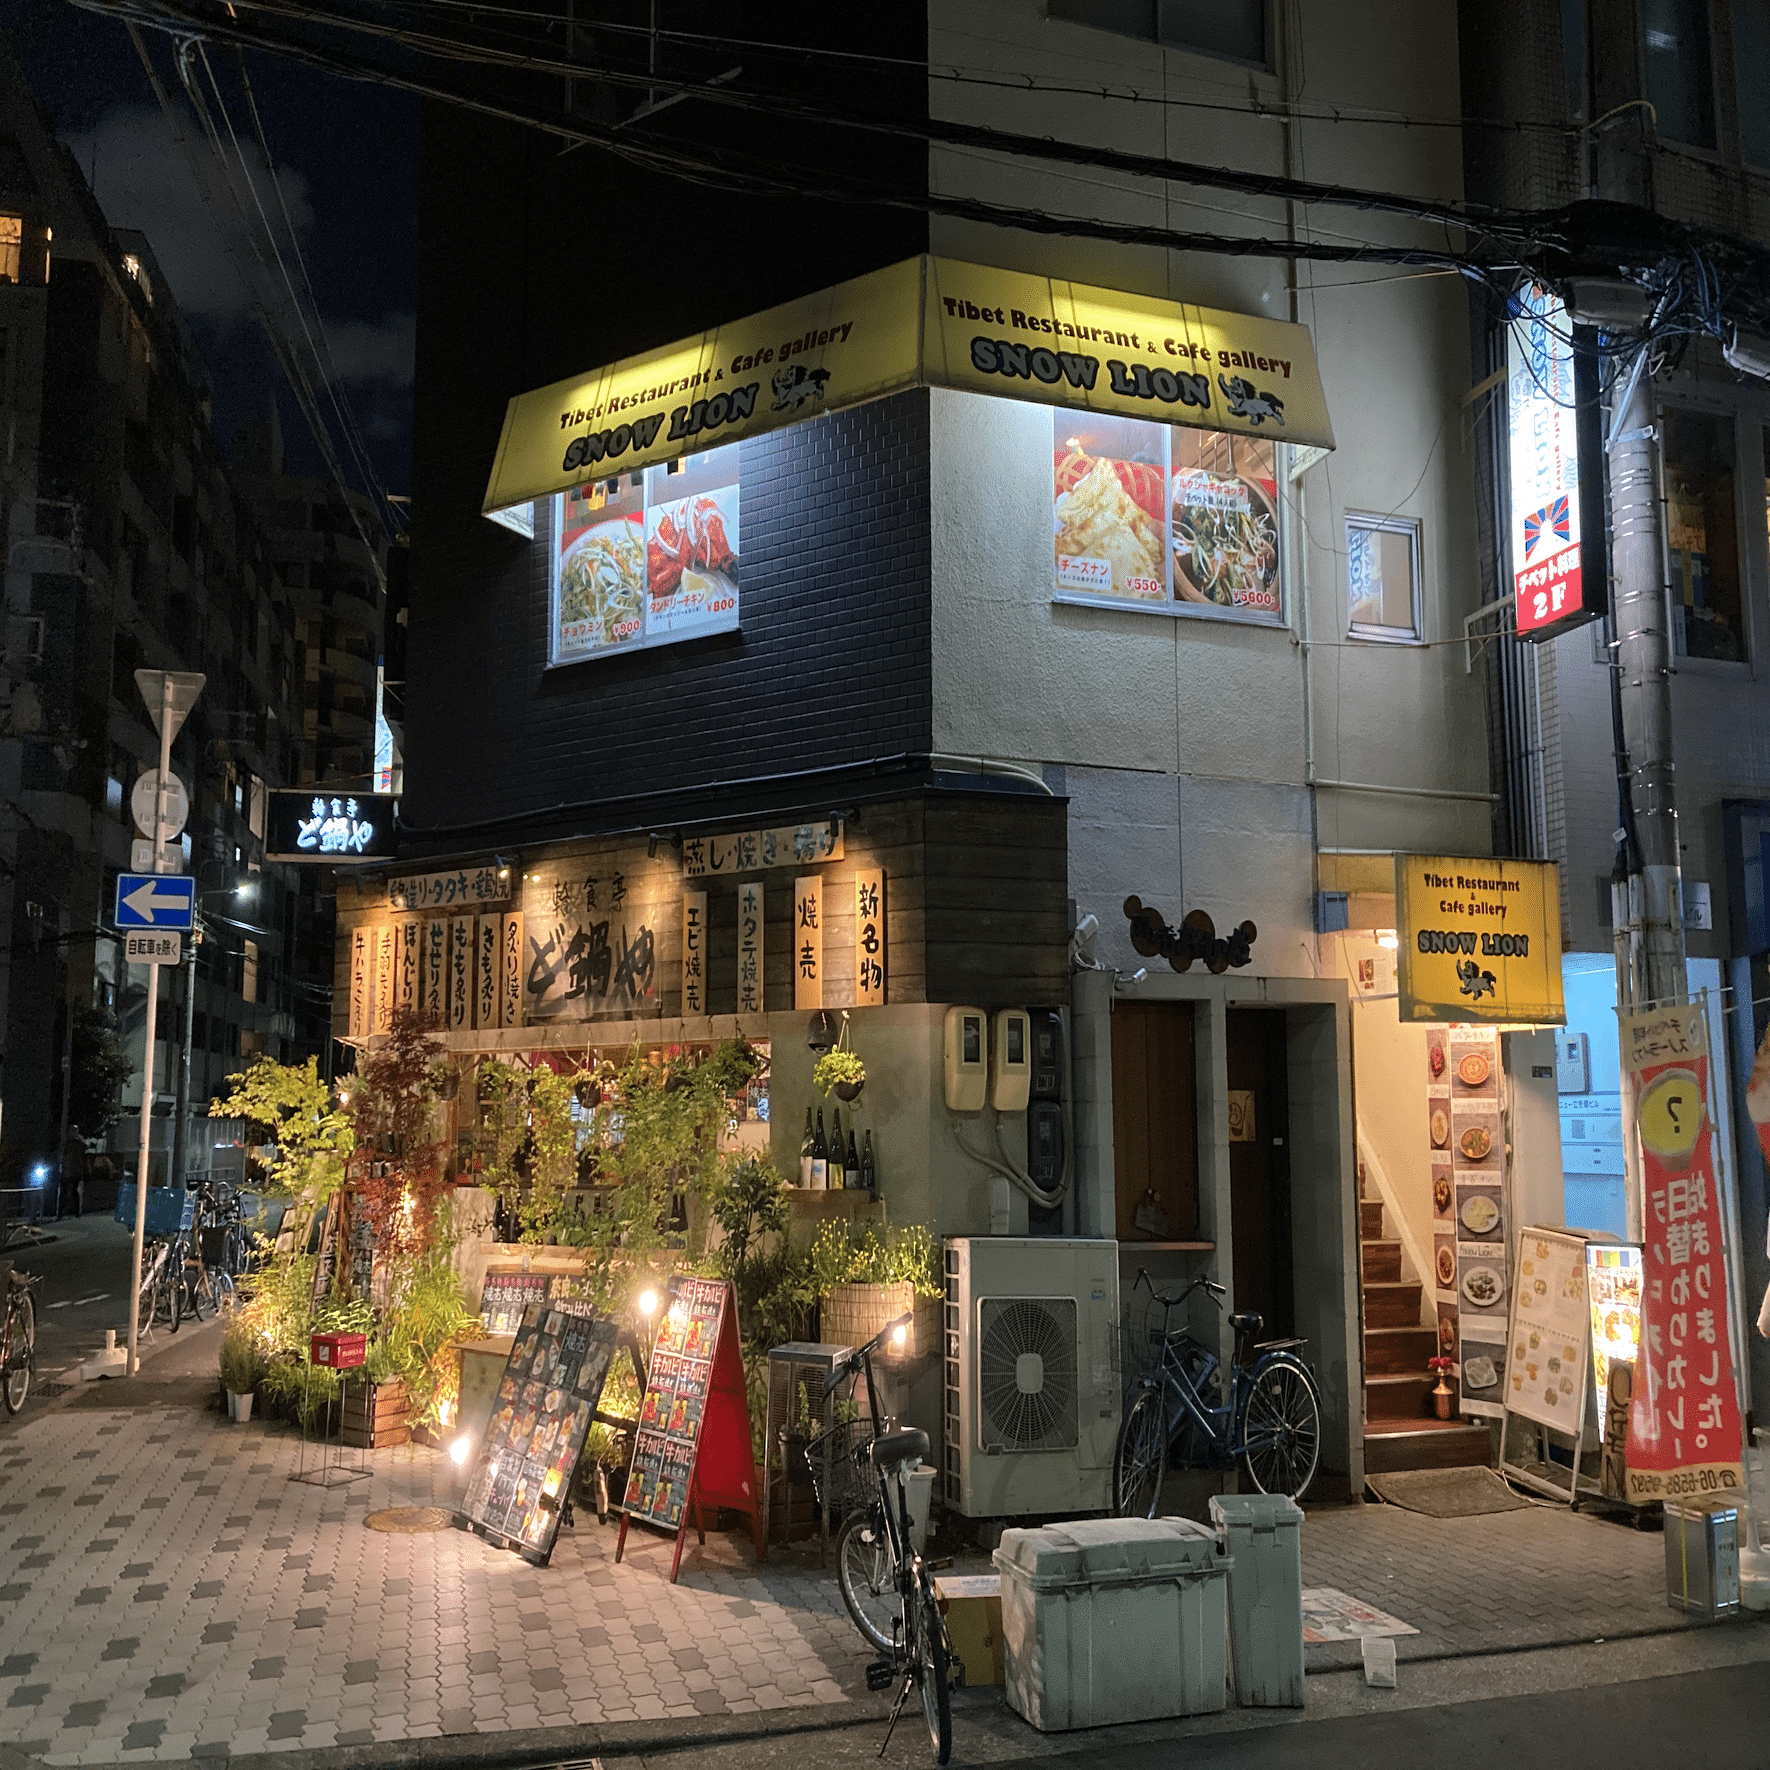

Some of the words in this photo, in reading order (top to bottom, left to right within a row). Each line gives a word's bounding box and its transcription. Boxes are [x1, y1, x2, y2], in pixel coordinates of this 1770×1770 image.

[560, 403, 603, 430] Tibet
[608, 368, 711, 414] Restaurant
[714, 368, 725, 381] &
[731, 347, 774, 375] Cafe
[779, 320, 855, 362] gallery
[942, 297, 1005, 325] Tibet
[1010, 309, 1141, 349] Restaurant
[1147, 341, 1159, 354] &
[1164, 337, 1211, 362] Cafe
[1217, 349, 1291, 378] gallery
[970, 336, 1099, 390] SNOW
[1107, 359, 1210, 409] LION
[563, 412, 665, 472] SNOW
[667, 383, 759, 442] LION
[650, 594, 705, 613] タンドリーチキン
[1061, 559, 1108, 576] チーズナン
[1533, 581, 1567, 620] 2F
[563, 621, 602, 639] チョウミン
[296, 817, 373, 853] ど鍋や
[1424, 873, 1454, 888] Tibet
[1457, 875, 1520, 892] Restaurant
[1440, 900, 1465, 914] Cafe
[1468, 901, 1507, 918] gallery
[1470, 892, 1476, 901] &
[128, 938, 178, 955] 自転車を除く
[481, 925, 495, 1022] きも炙り
[505, 920, 520, 1024] 炙り焼き
[527, 920, 655, 1000] ど鍋や
[685, 907, 701, 1011] エビ焼売
[741, 889, 759, 1012] ホタテ焼売
[799, 893, 819, 980] 焼売
[858, 882, 882, 992] 新名物
[1417, 930, 1477, 955] SNOW
[1481, 932, 1529, 958] LION
[453, 926, 466, 1025] もも炙り
